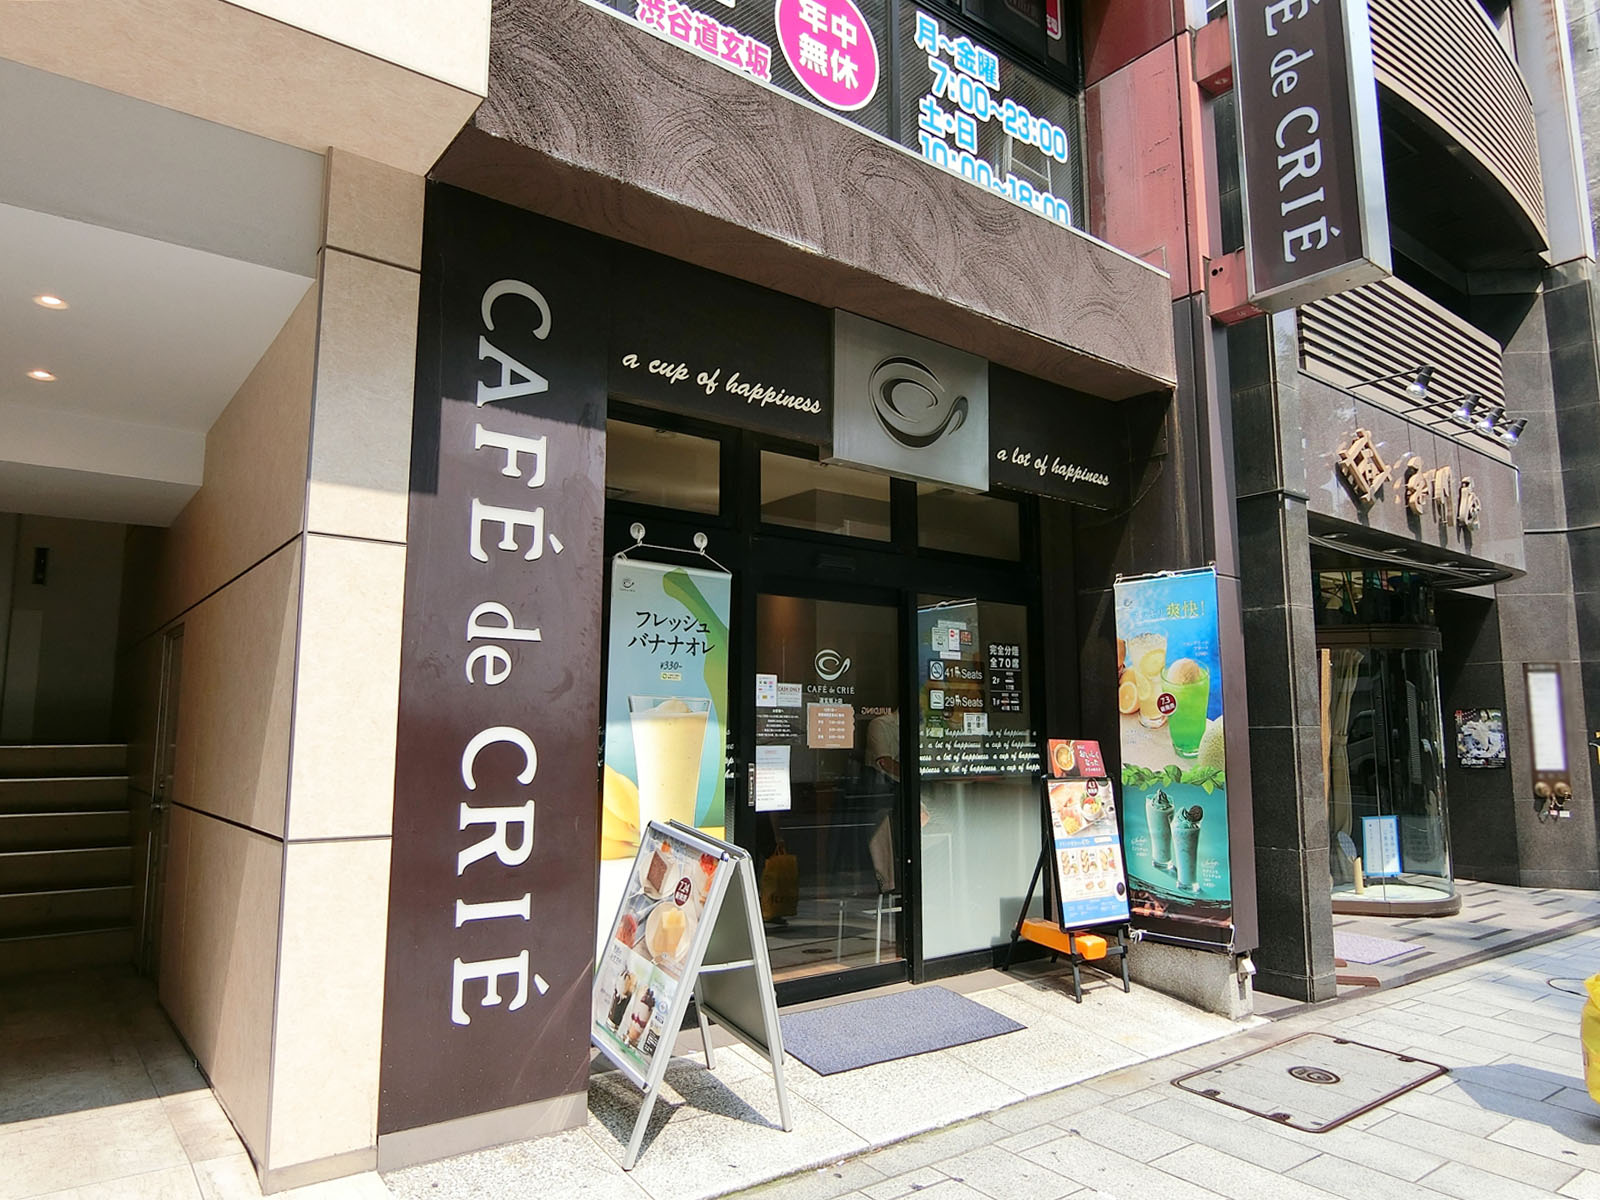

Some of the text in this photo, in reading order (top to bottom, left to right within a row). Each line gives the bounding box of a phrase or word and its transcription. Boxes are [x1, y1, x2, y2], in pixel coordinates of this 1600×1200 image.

[799, 0, 858, 49] 年中
[799, 34, 859, 90] 無休
[1270, 49, 1315, 98] de
[1275, 106, 1340, 262] CRIÉ
[622, 354, 822, 414] a cup of happiness
[997, 447, 1110, 486] a lot of happiness
[636, 611, 711, 633] フレッシュ
[451, 279, 564, 1026] CAFÉ de CRIÉ
[628, 633, 716, 656] バナナオレ
[807, 684, 827, 694] CAFÉ
[961, 669, 983, 680] Seats
[945, 696, 983, 708] 29 Seats
